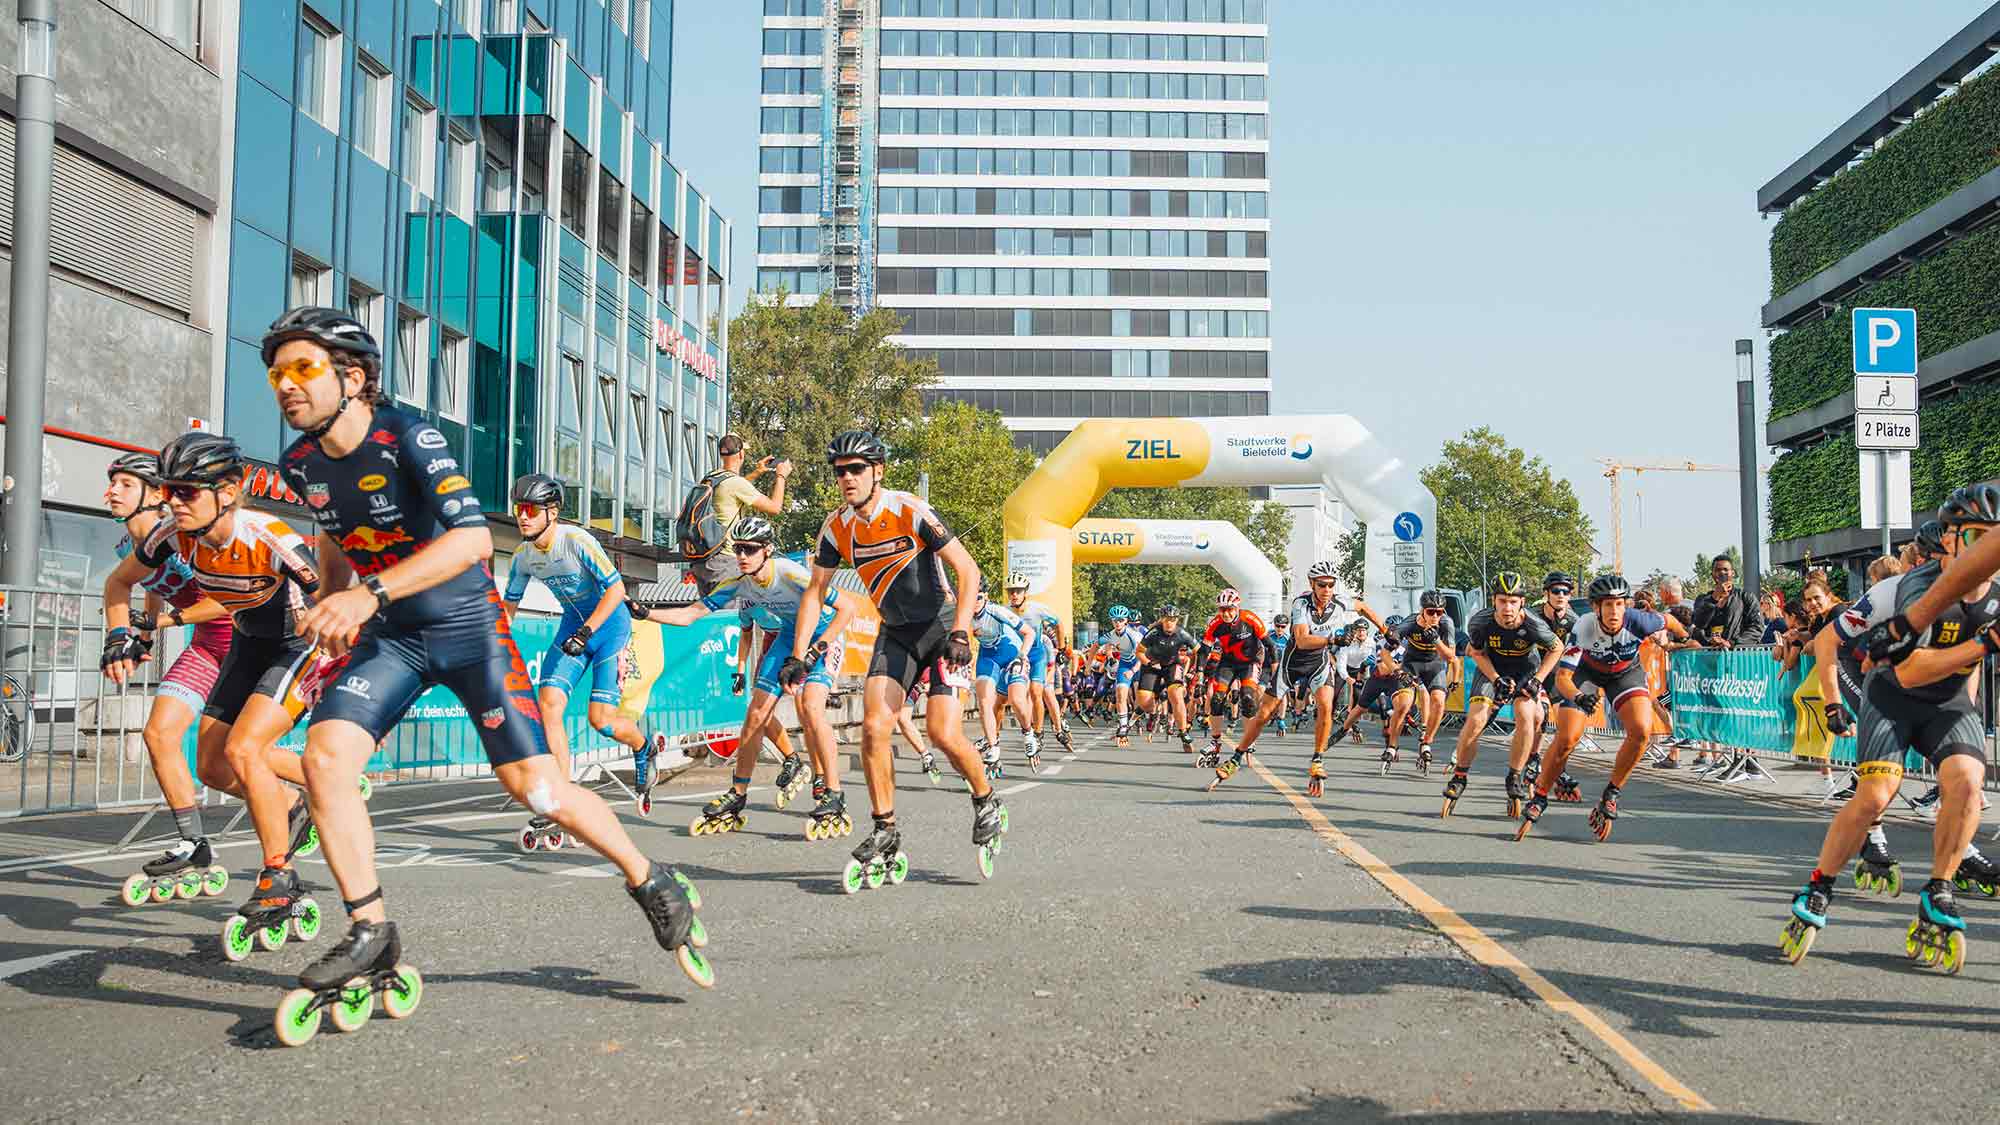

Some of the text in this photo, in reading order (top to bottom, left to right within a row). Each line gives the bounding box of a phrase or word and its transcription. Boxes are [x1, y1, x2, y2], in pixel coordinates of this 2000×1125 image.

[1868, 317, 1901, 366] P
[657, 319, 717, 383] RESTAURANT
[1865, 422, 1911, 438] 2 Plätze
[1127, 439, 1181, 459] ZIEL
[1226, 437, 1287, 447] Stadtwerke
[1242, 447, 1287, 457] Bielefeld
[1078, 531, 1136, 545] START
[1701, 672, 1769, 705] erstklassig!
